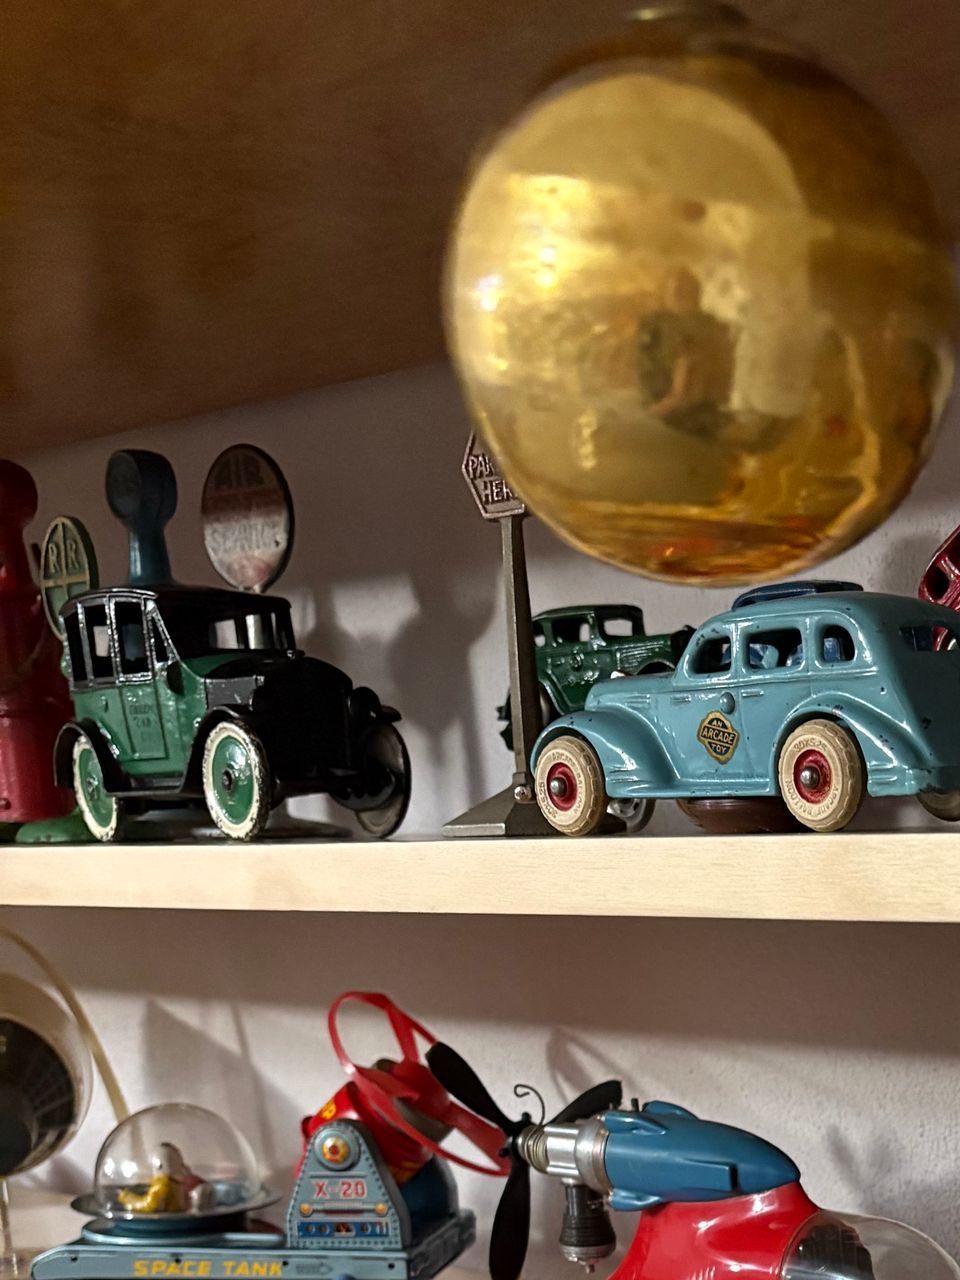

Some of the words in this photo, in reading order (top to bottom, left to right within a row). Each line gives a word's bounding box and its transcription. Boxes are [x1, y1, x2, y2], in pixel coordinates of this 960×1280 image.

[711, 719, 723, 728] AN
[702, 727, 735, 744] ARCADE
[711, 743, 727, 753] TOY
[133, 1259, 212, 1278] SPACE
[223, 1259, 283, 1277] TANK
